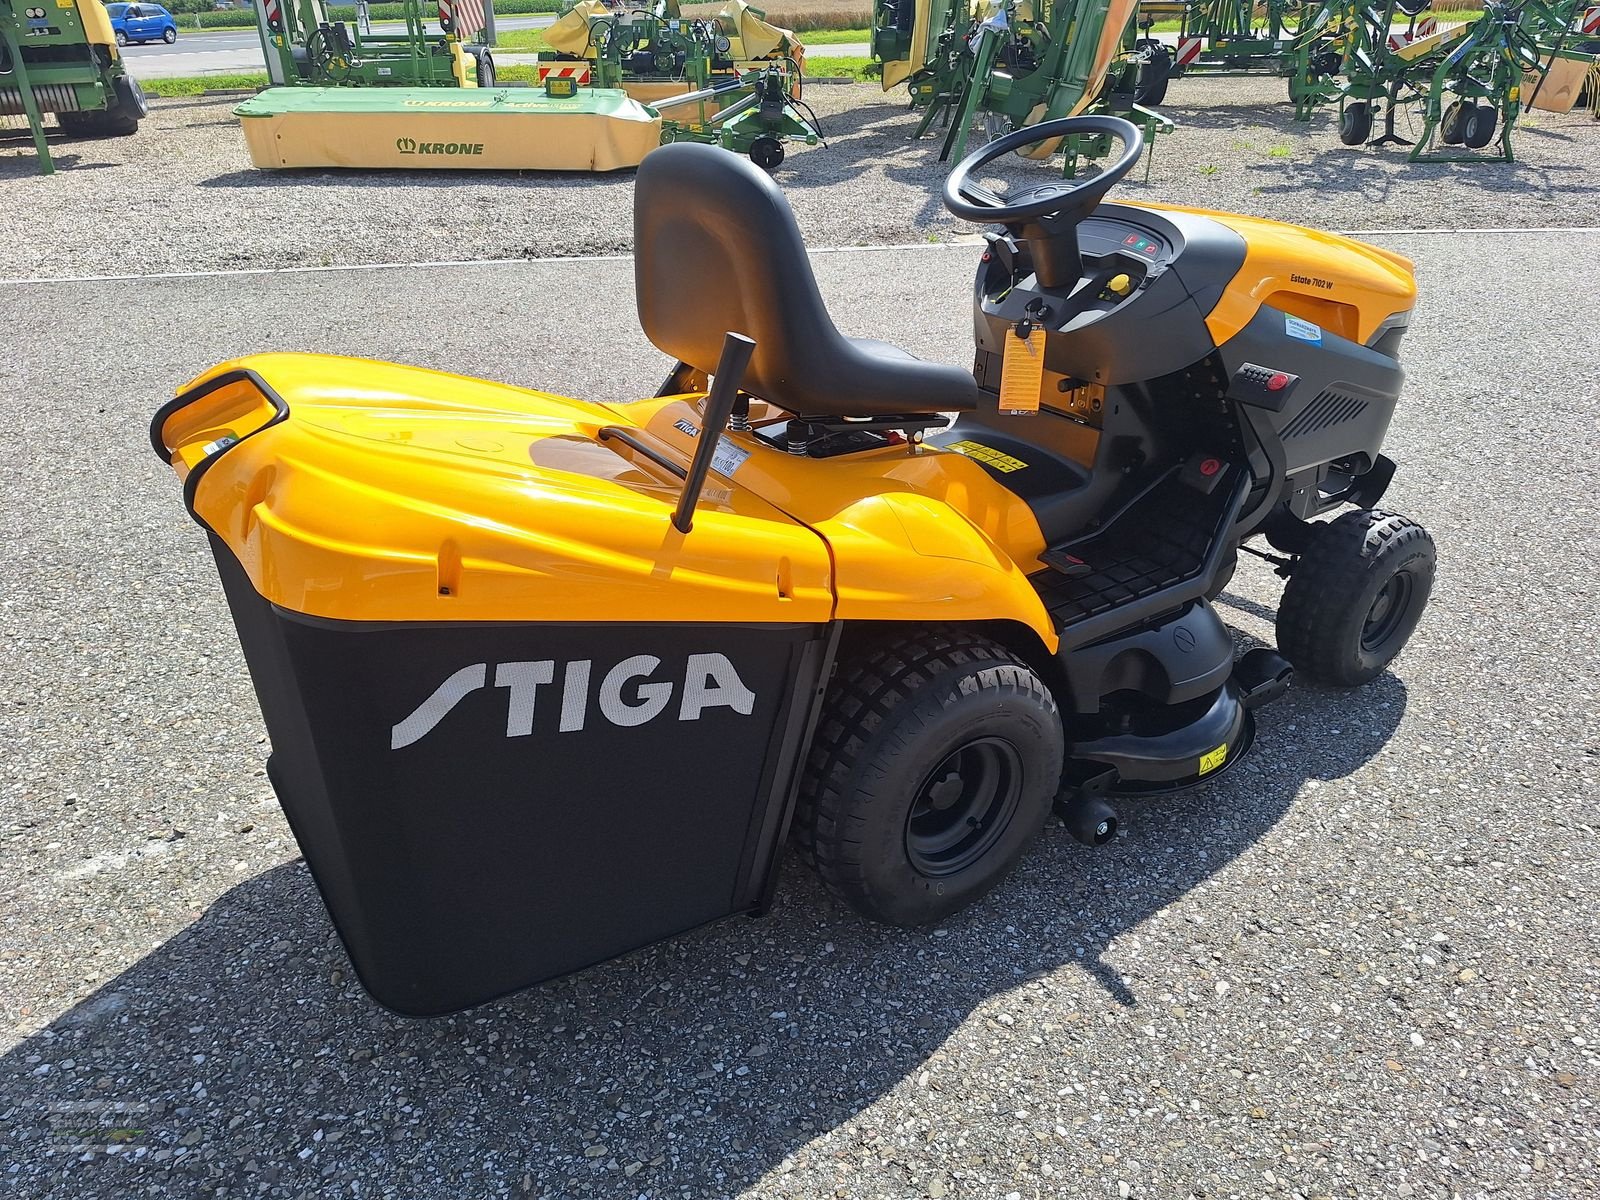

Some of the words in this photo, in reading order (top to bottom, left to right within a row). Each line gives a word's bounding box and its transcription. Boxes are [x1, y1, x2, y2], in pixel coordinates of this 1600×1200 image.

[418, 142, 484, 155] KRONE
[1290, 273, 1311, 286] Estate
[1311, 277, 1326, 288] 7102
[1326, 281, 1334, 290] W
[674, 420, 698, 437] STIGA
[391, 652, 756, 751] STIGA
